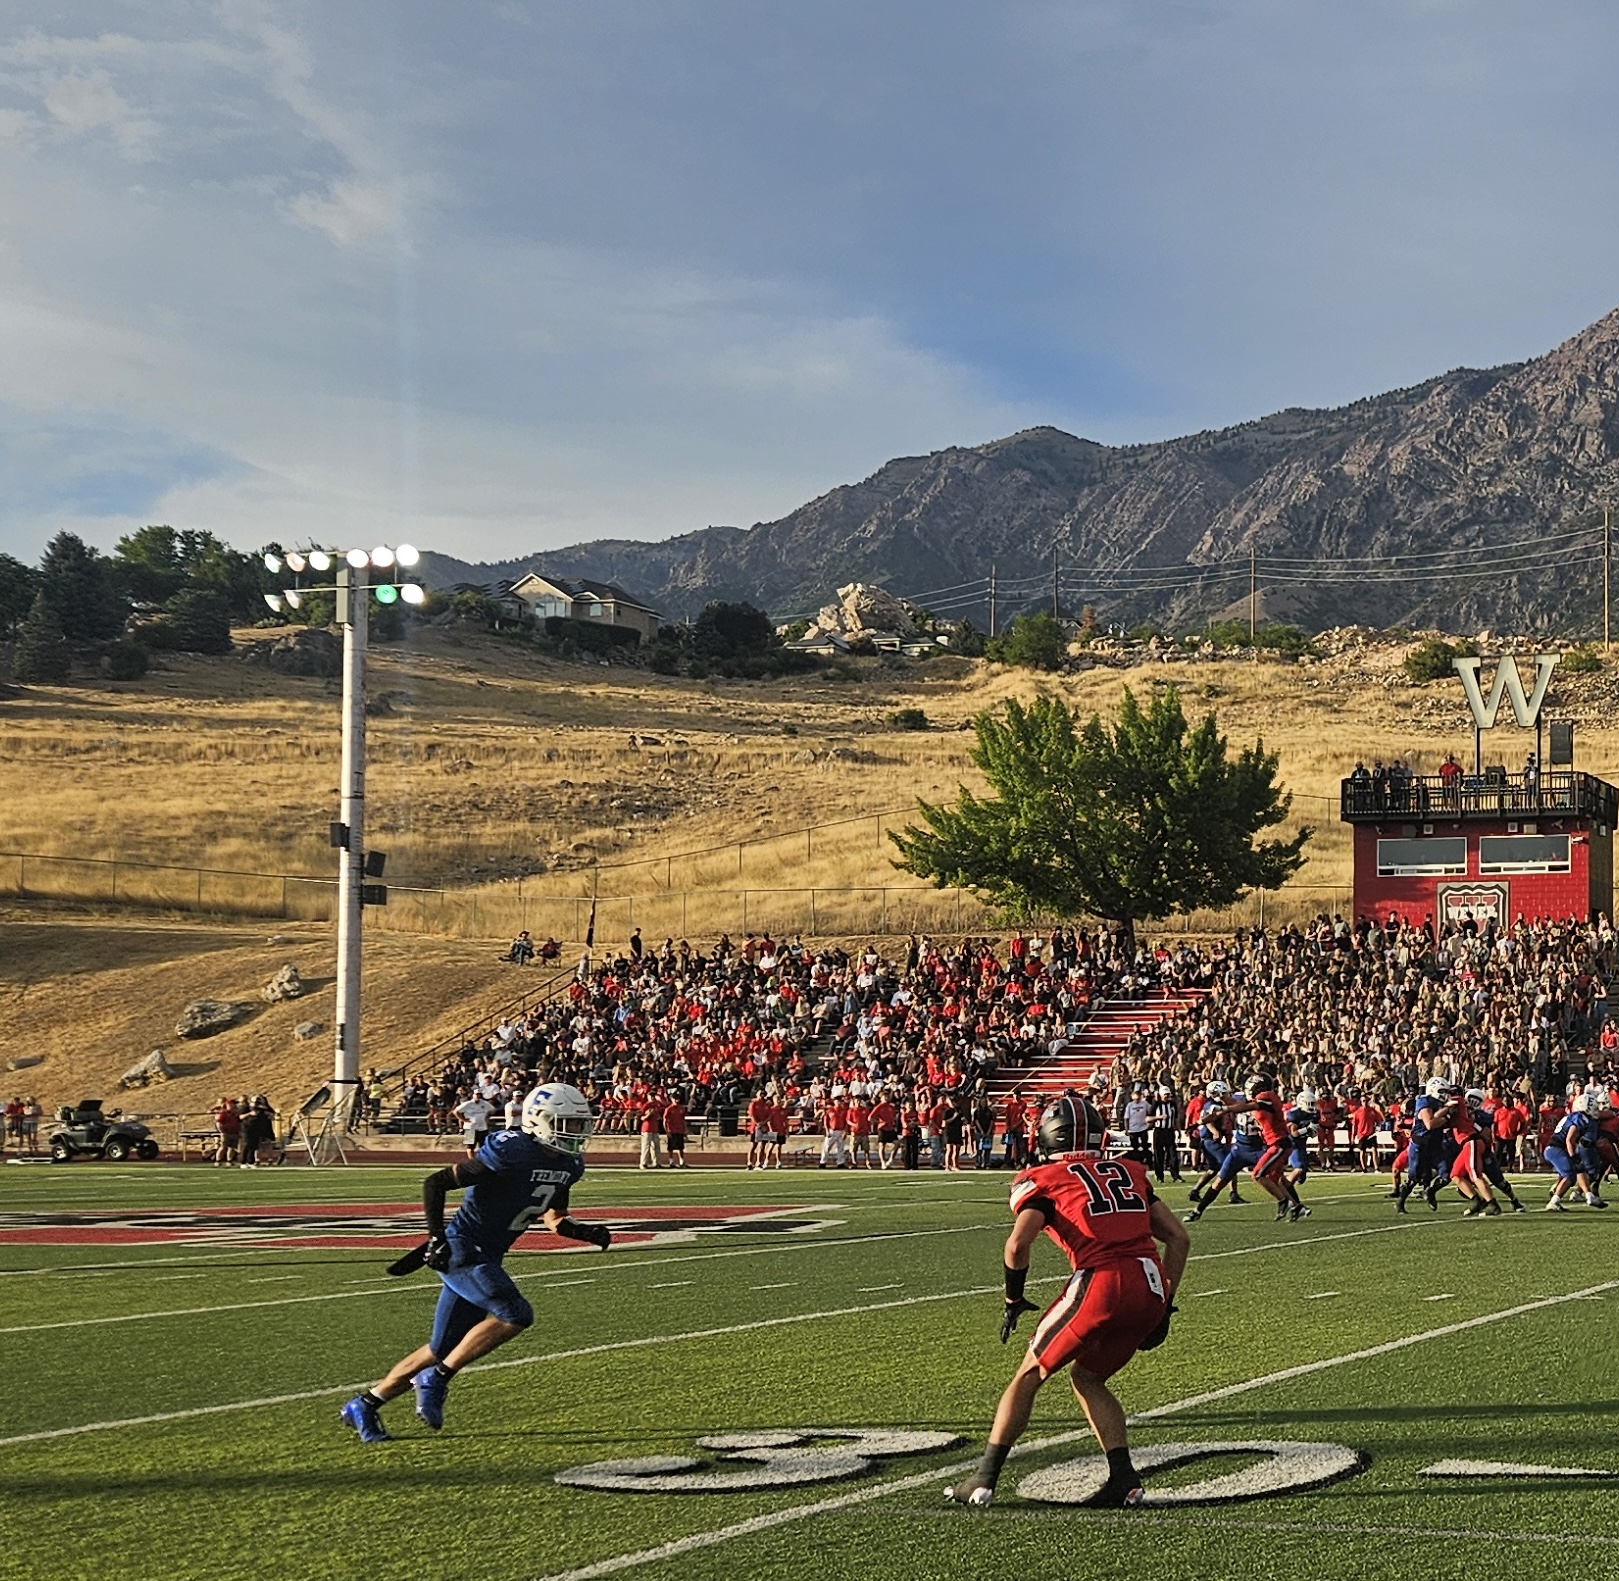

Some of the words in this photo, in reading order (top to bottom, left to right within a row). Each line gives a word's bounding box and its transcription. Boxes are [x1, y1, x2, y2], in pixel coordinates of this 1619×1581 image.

[1452, 653, 1562, 729] W
[508, 1185, 556, 1231] 2
[1068, 1161, 1146, 1216] 12
